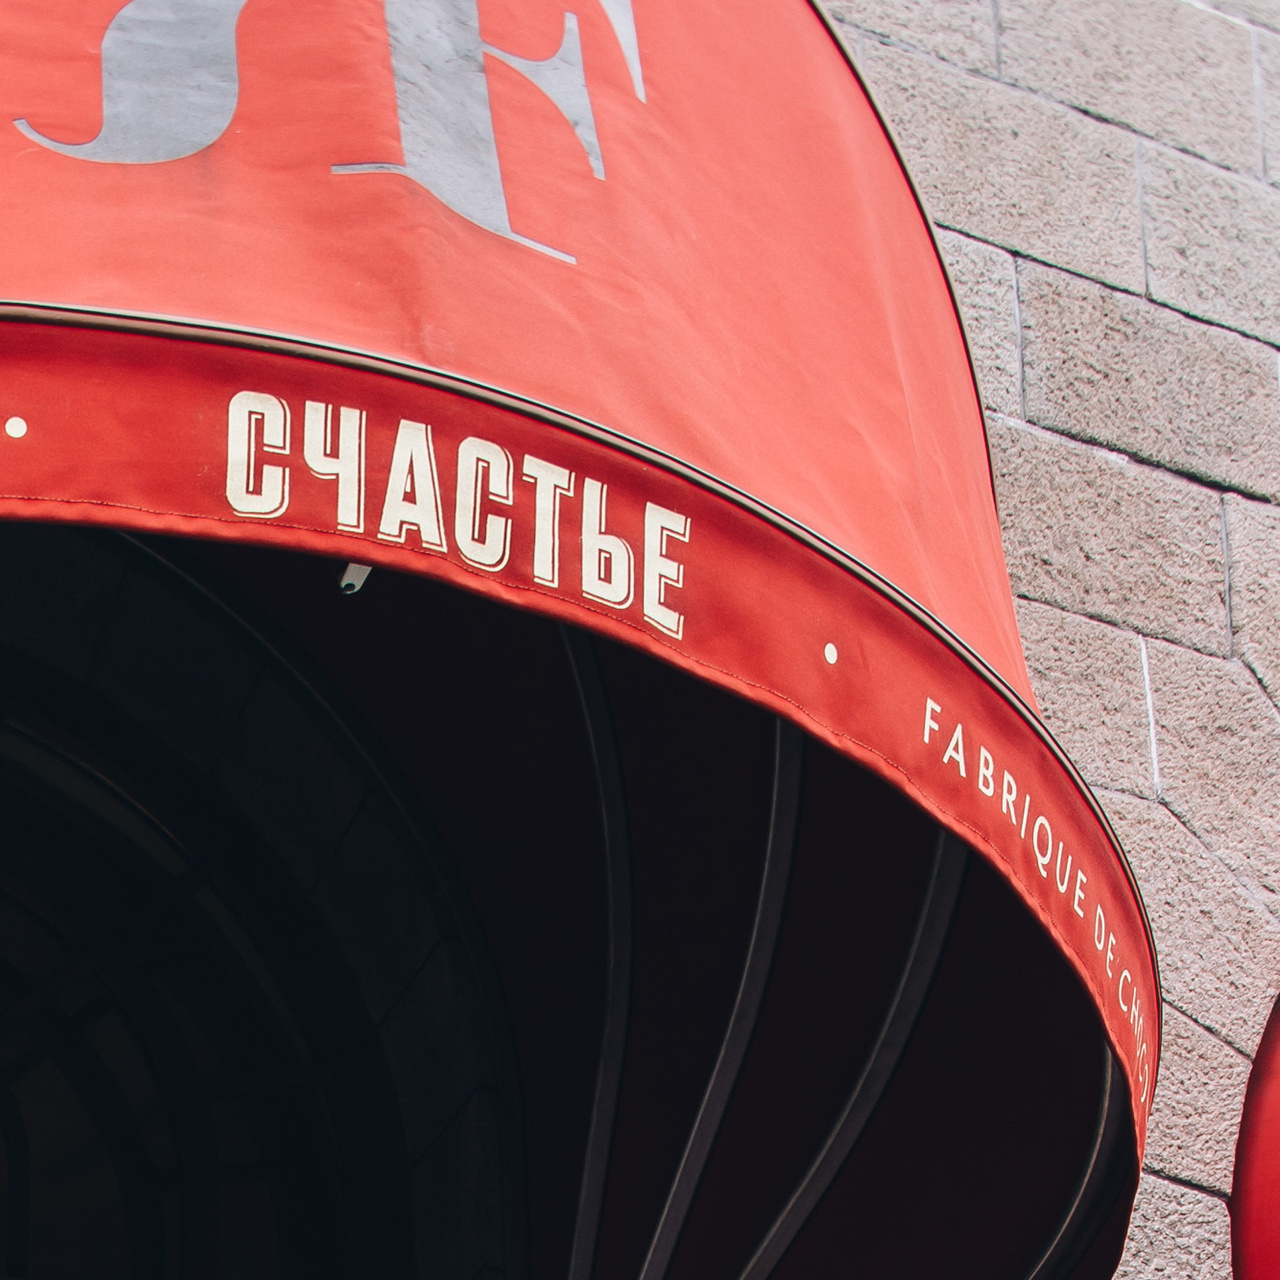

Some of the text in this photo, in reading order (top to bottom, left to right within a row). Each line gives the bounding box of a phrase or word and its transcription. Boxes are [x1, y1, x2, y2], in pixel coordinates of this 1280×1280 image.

[224, 390, 691, 641] СЧАСТЬЕ
[923, 696, 1088, 918] FABRIQUE
[1094, 904, 1117, 979] DE
